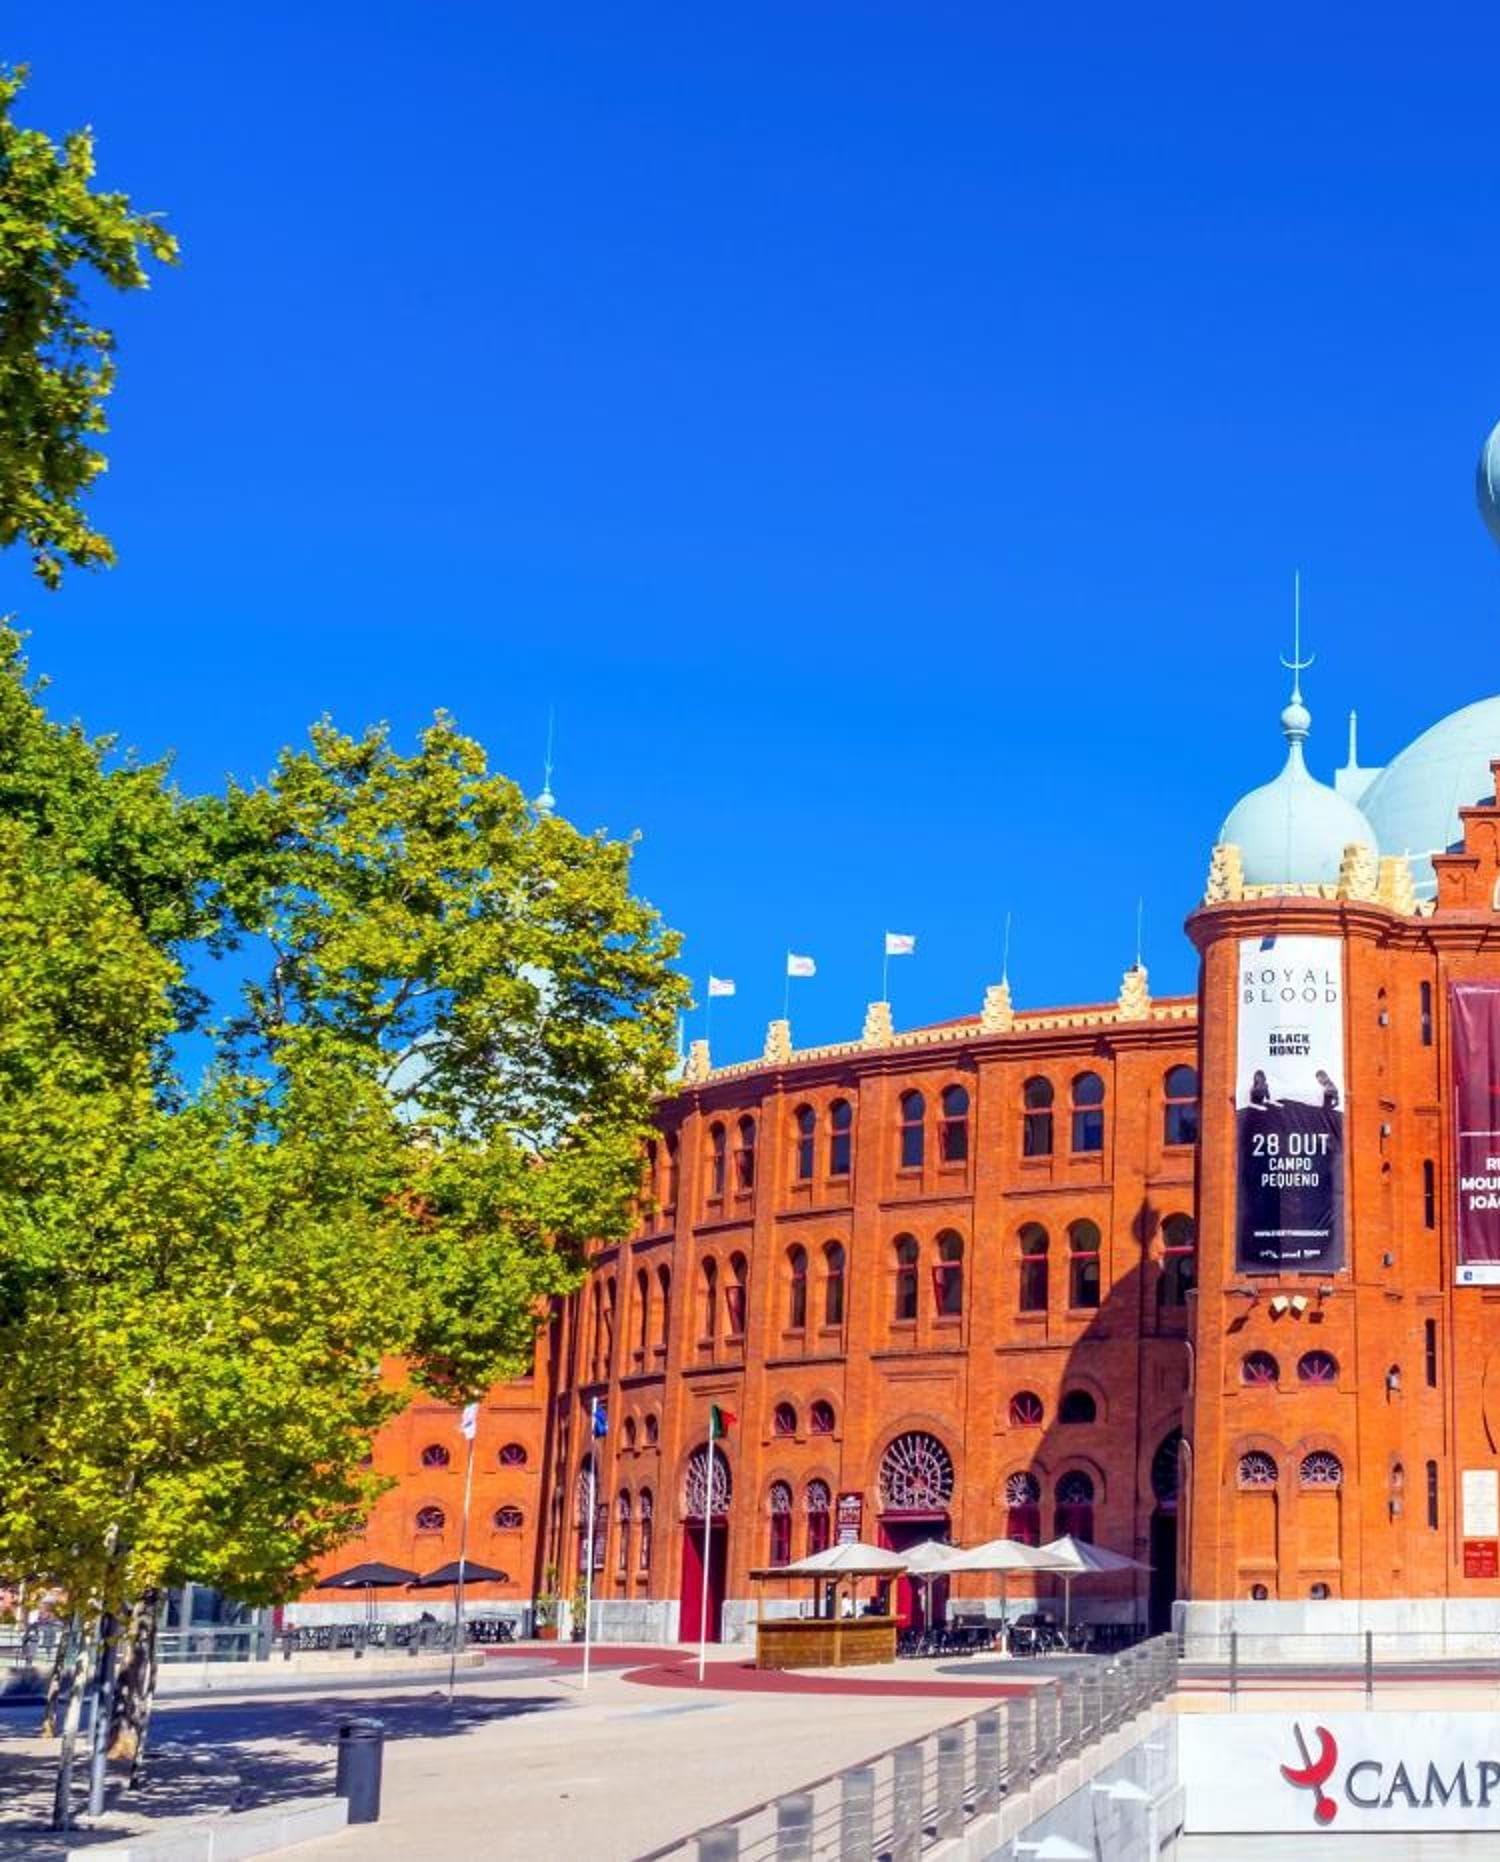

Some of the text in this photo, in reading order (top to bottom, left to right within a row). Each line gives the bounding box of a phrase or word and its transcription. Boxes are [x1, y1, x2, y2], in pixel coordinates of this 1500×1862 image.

[1244, 968, 1337, 985] ROYAL
[1244, 987, 1337, 1004] BLOOD
[1269, 1033, 1310, 1045] BLACK
[1269, 1045, 1311, 1056] HONEY
[1252, 1133, 1329, 1156] 28 OUT
[1269, 1157, 1312, 1171] CAMPO
[1261, 1173, 1319, 1188] PEQUENO
